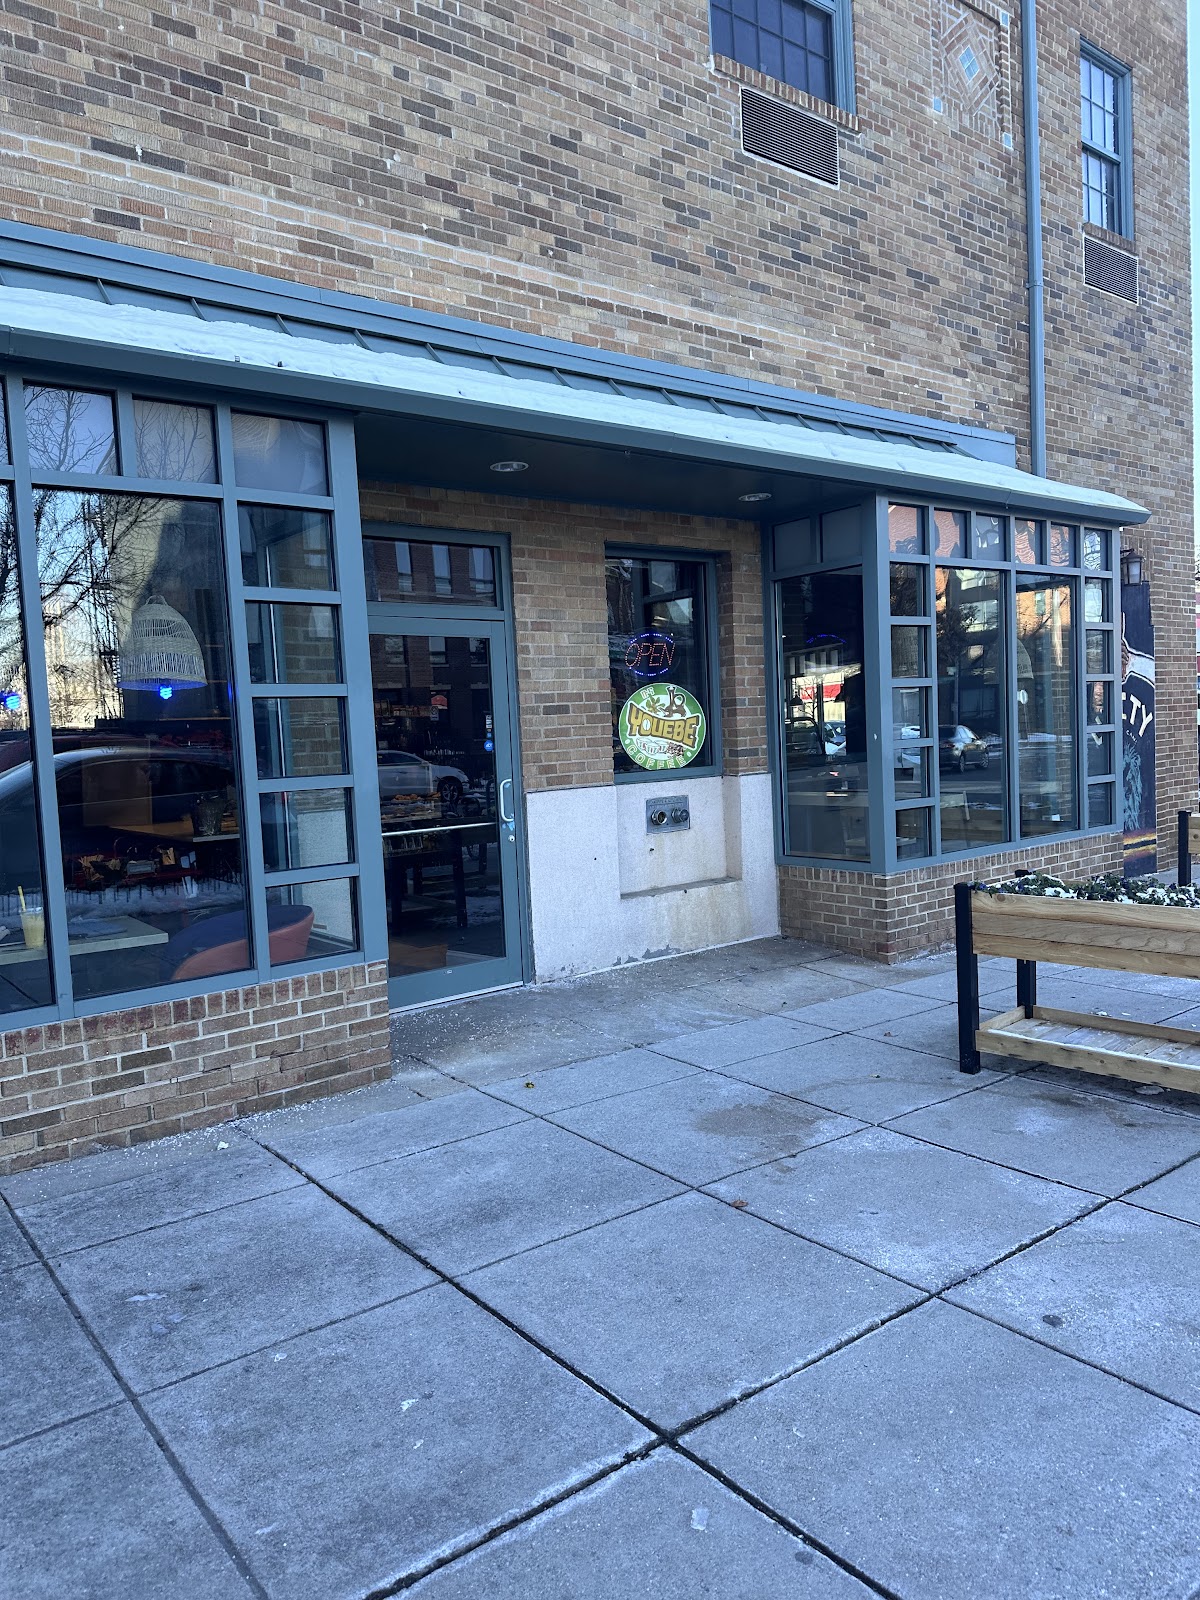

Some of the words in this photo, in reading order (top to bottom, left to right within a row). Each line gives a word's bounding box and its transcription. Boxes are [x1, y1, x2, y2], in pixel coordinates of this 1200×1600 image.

[625, 642, 676, 667] OPEN
[627, 701, 701, 750] YOUEBE
[626, 745, 687, 770] COFFEE
